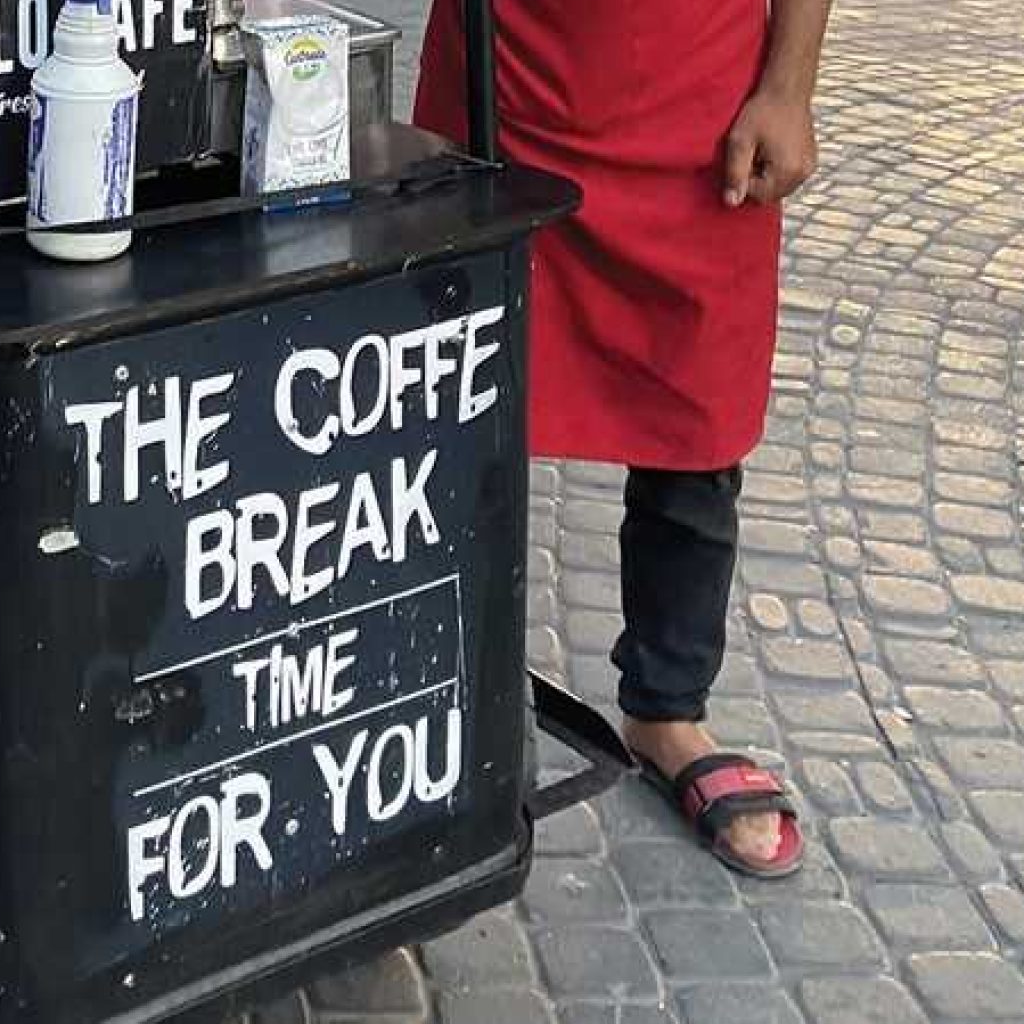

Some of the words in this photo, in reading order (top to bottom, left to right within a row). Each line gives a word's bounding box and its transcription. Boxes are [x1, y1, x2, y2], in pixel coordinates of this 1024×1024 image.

[64, 372, 236, 504] THE
[275, 305, 506, 456] COFFE
[184, 449, 441, 620] BREAK
[232, 627, 360, 733] TIME
[127, 772, 274, 922] FOR
[311, 707, 463, 836] YOU
